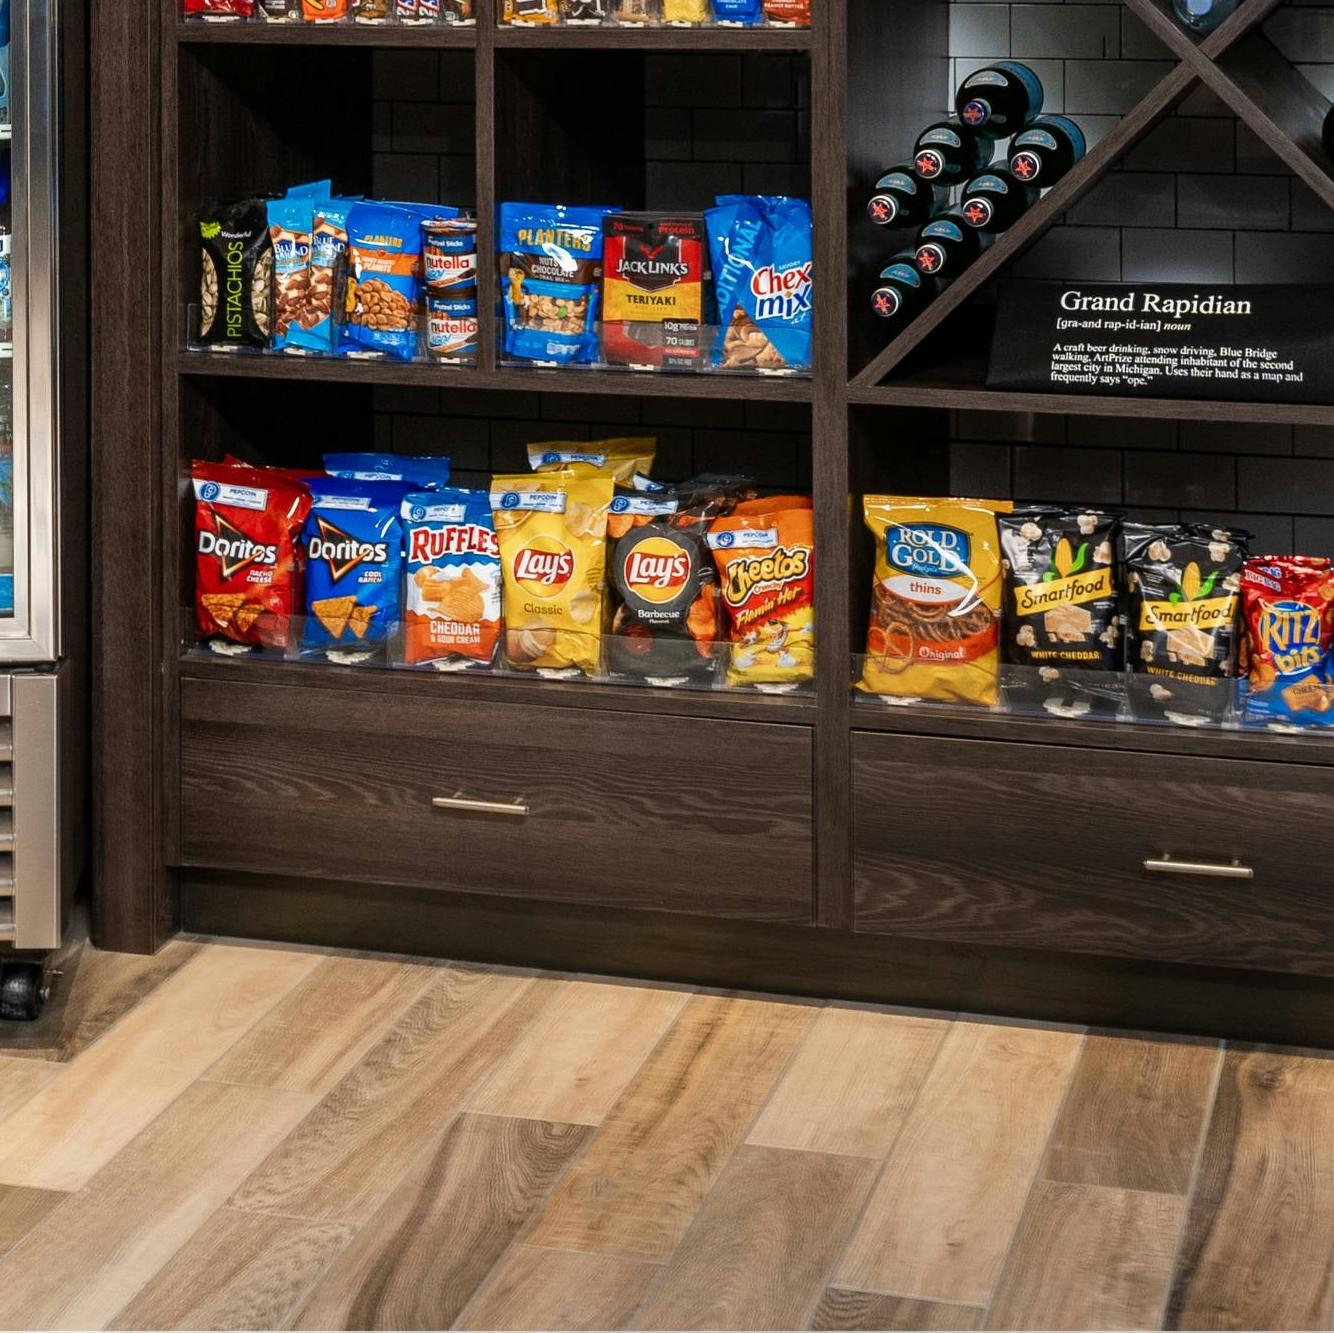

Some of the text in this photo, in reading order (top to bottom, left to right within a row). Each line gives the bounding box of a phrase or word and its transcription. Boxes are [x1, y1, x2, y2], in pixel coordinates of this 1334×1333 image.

[518, 229, 592, 252] PLANTERS
[426, 254, 470, 269] nutella
[616, 259, 647, 274] JACK
[227, 241, 243, 338] PISTACHIOS
[752, 263, 812, 295] Chex
[626, 294, 676, 306] TERIYAKI
[757, 290, 812, 320] mix
[1060, 290, 1252, 319] Grand Rapidian
[430, 319, 476, 334] nutella
[1056, 317, 1192, 332] [gra-and rap-id-ian] noun
[1053, 343, 1062, 352] A
[1063, 343, 1085, 352] craft
[1087, 343, 1107, 353] beer
[1153, 347, 1178, 355] snow
[1220, 347, 1243, 357] Blue
[1245, 348, 1278, 361] Bridge
[1093, 353, 1132, 363] ArtPrize
[1134, 355, 1178, 366] attending
[1180, 356, 1228, 368] inhabitant
[1230, 358, 1242, 368] of
[1243, 358, 1258, 369] the
[1260, 361, 1294, 370] second
[1051, 361, 1081, 372] largest
[1083, 362, 1101, 374] city
[1103, 363, 1113, 373] in
[1165, 365, 1188, 376] Uses
[1190, 367, 1213, 377] their
[1215, 368, 1239, 378] hand
[1261, 374, 1283, 383] map
[1284, 372, 1304, 382] and
[1051, 371, 1098, 385] frequently
[1099, 376, 1121, 386] says
[198, 530, 278, 565] Doritos
[308, 536, 388, 563] Doritos
[411, 525, 500, 562] RUFFLES
[898, 528, 958, 549] ROLD
[516, 547, 572, 586] Lay's
[891, 543, 962, 573] GOLD
[628, 553, 688, 588] Lay's
[727, 549, 808, 602] Cheetos
[909, 580, 942, 596] thins
[1020, 575, 1105, 610] Smartfood
[522, 602, 564, 617] Classic
[637, 609, 680, 619] Barbecue
[429, 620, 480, 636] CHEDDAR
[1264, 609, 1321, 651] RITZ
[918, 645, 966, 661] Original
[1031, 650, 1100, 660] WHITE CHEDDAR
[1273, 646, 1322, 673] bits
